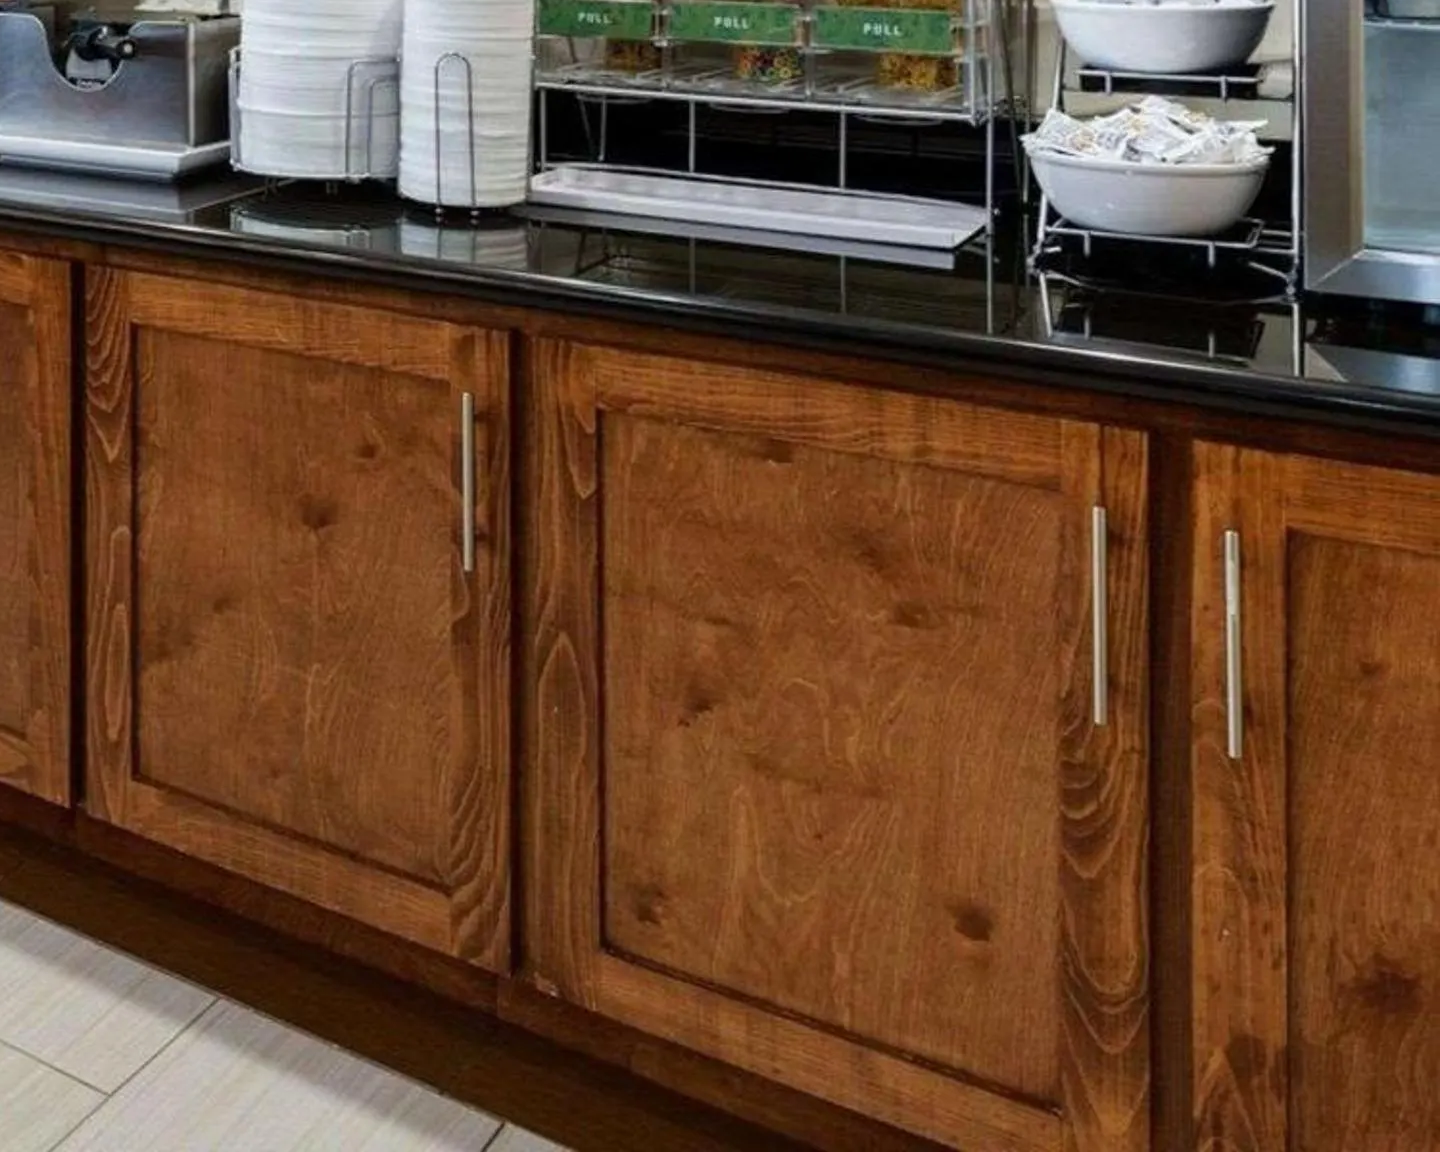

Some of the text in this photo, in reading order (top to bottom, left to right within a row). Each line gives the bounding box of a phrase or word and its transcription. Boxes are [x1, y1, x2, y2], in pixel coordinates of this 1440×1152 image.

[577, 12, 611, 24] PULL
[714, 16, 749, 29] PULL
[863, 22, 902, 37] PULL
